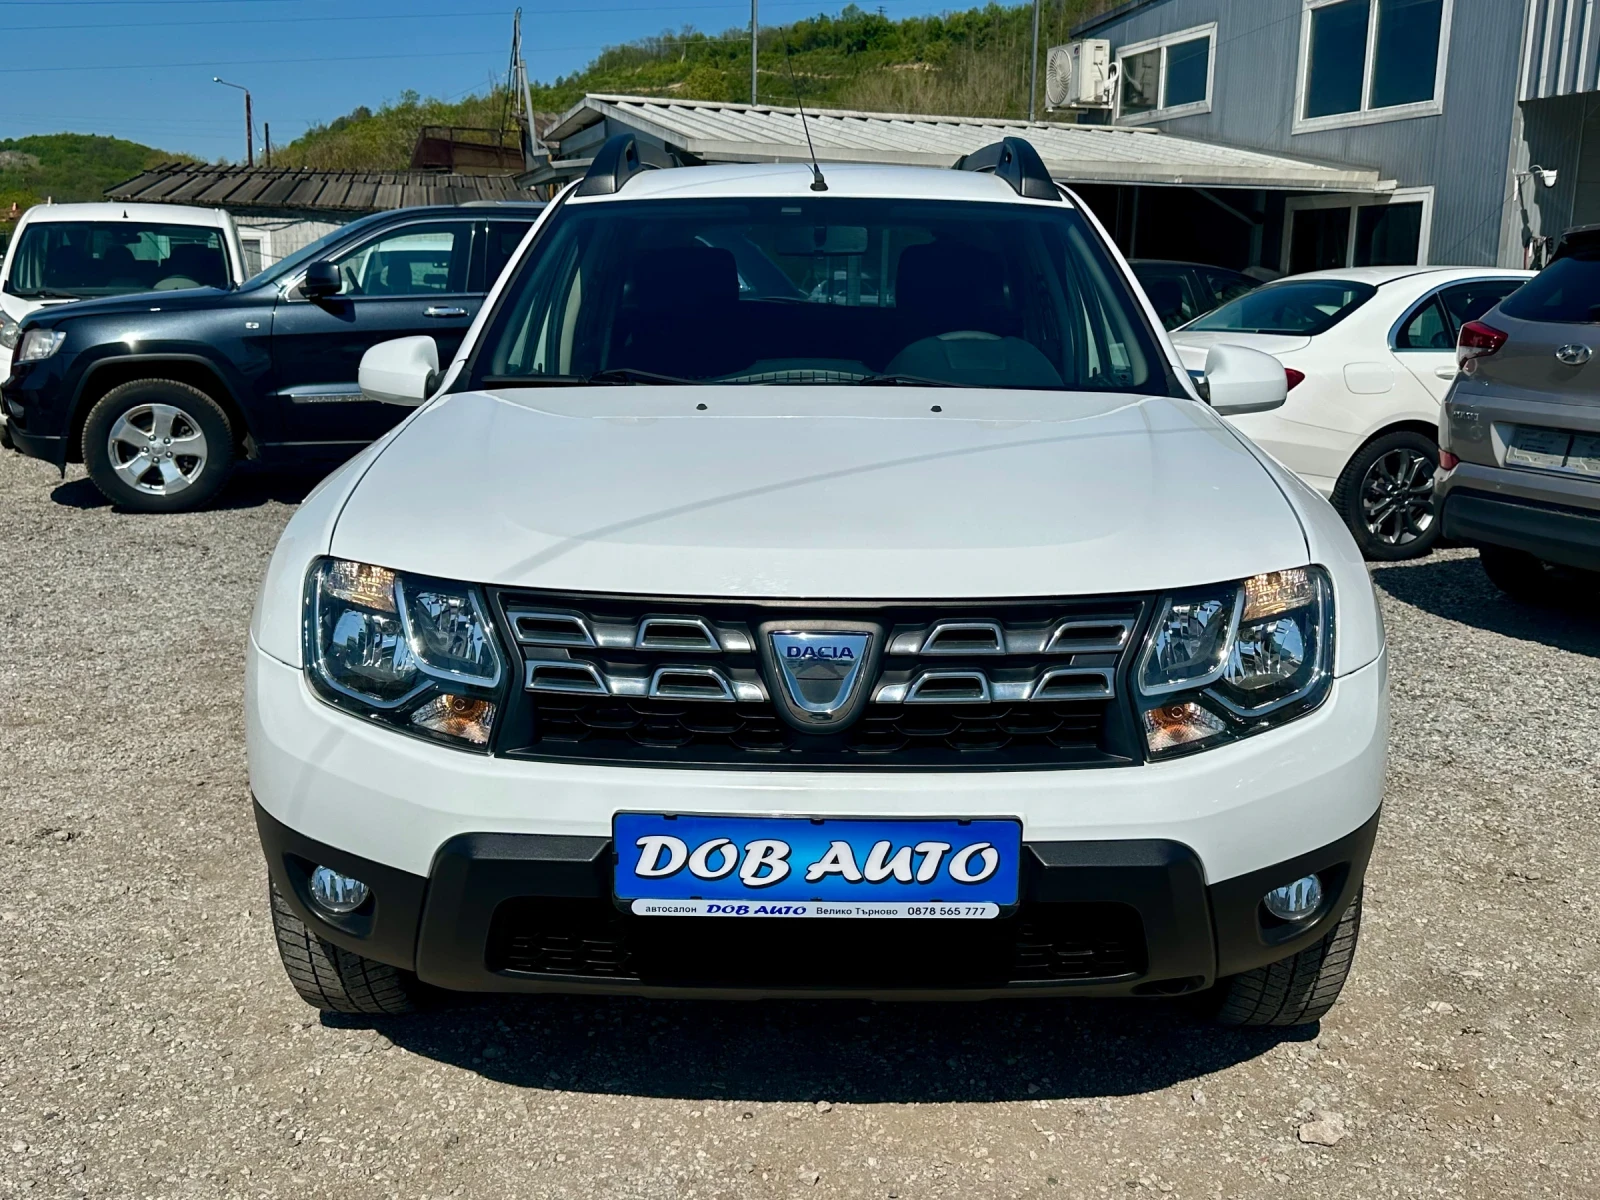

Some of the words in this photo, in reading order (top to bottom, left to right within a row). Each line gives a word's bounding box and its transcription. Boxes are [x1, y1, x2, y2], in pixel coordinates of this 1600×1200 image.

[786, 646, 854, 659] DACIA
[634, 835, 792, 889] DOB
[804, 840, 1000, 885] AUTO
[645, 905, 697, 913] автосалон
[706, 904, 750, 915] DOB
[753, 905, 807, 915] AUTO
[816, 907, 853, 915] Велико
[855, 907, 898, 916] Търново
[907, 906, 936, 916] 0878
[939, 906, 961, 916] 565
[964, 907, 986, 916] 777
